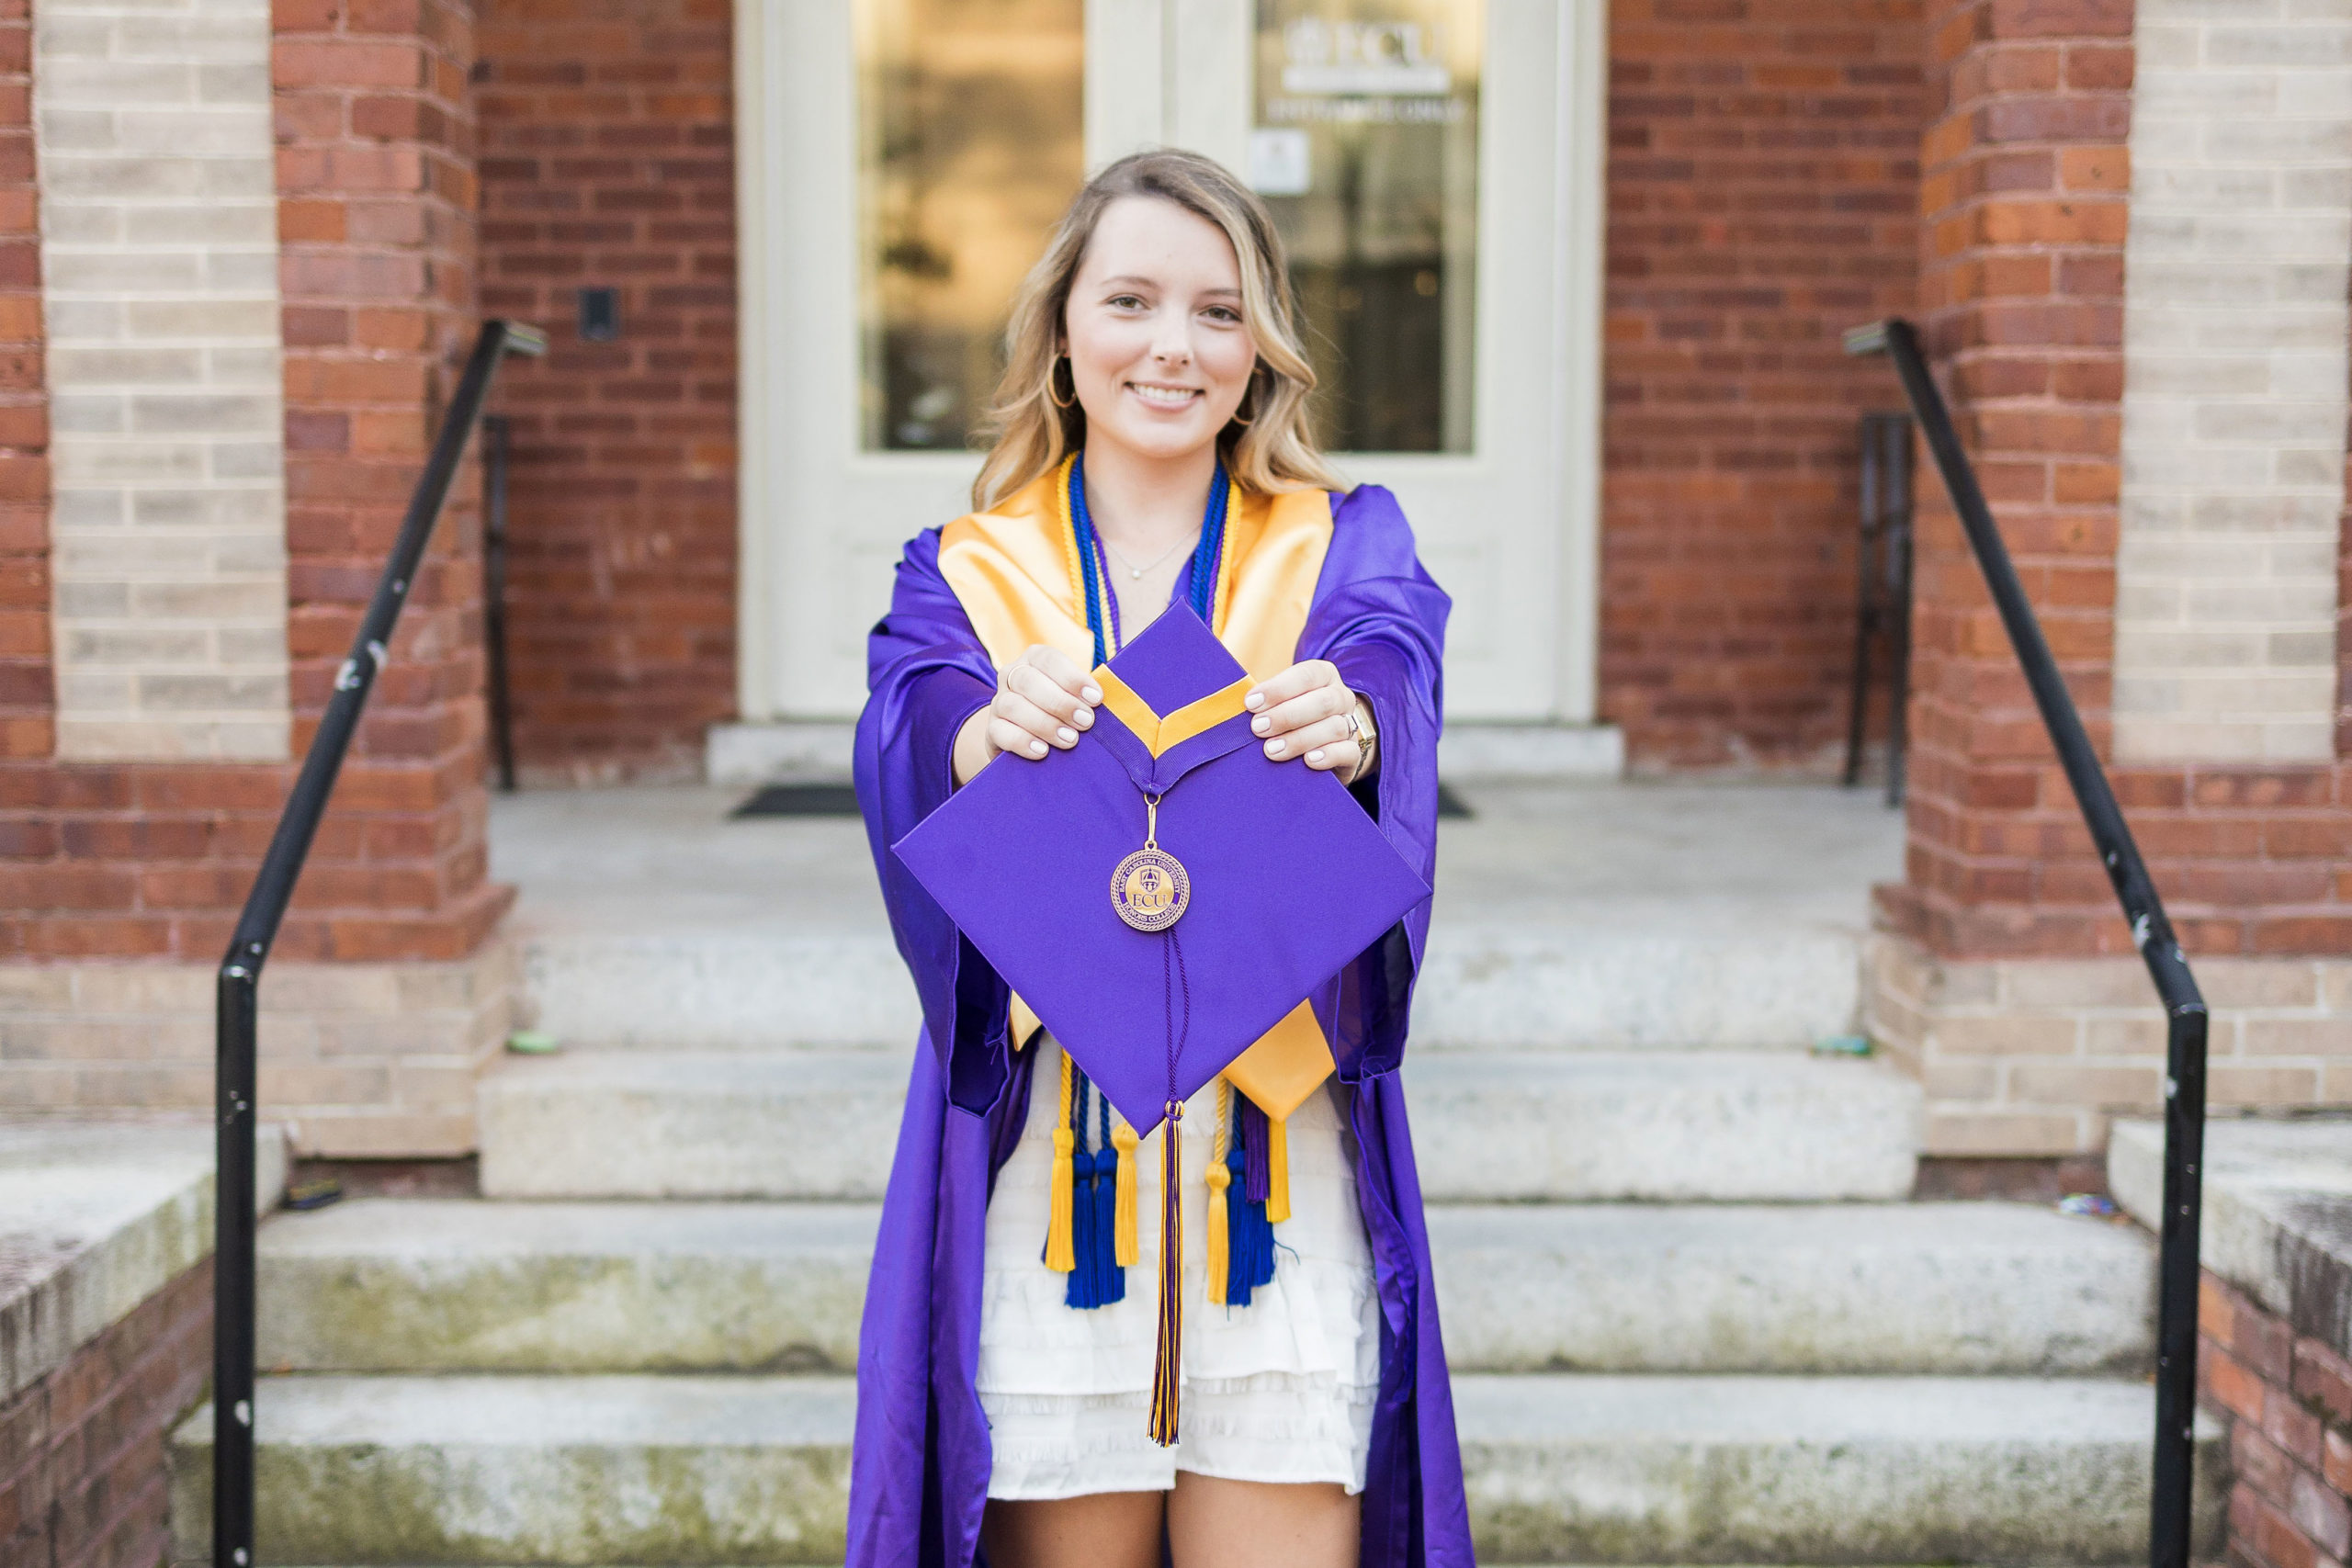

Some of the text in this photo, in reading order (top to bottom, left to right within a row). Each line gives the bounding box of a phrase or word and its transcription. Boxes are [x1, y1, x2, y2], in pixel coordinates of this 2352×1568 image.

[1125, 858, 1156, 874] CAROLINA
[1158, 860, 1181, 894] UNIVERSITY
[1133, 894, 1167, 908] ECU
[1122, 902, 1177, 921] HONORS COLLEGE
